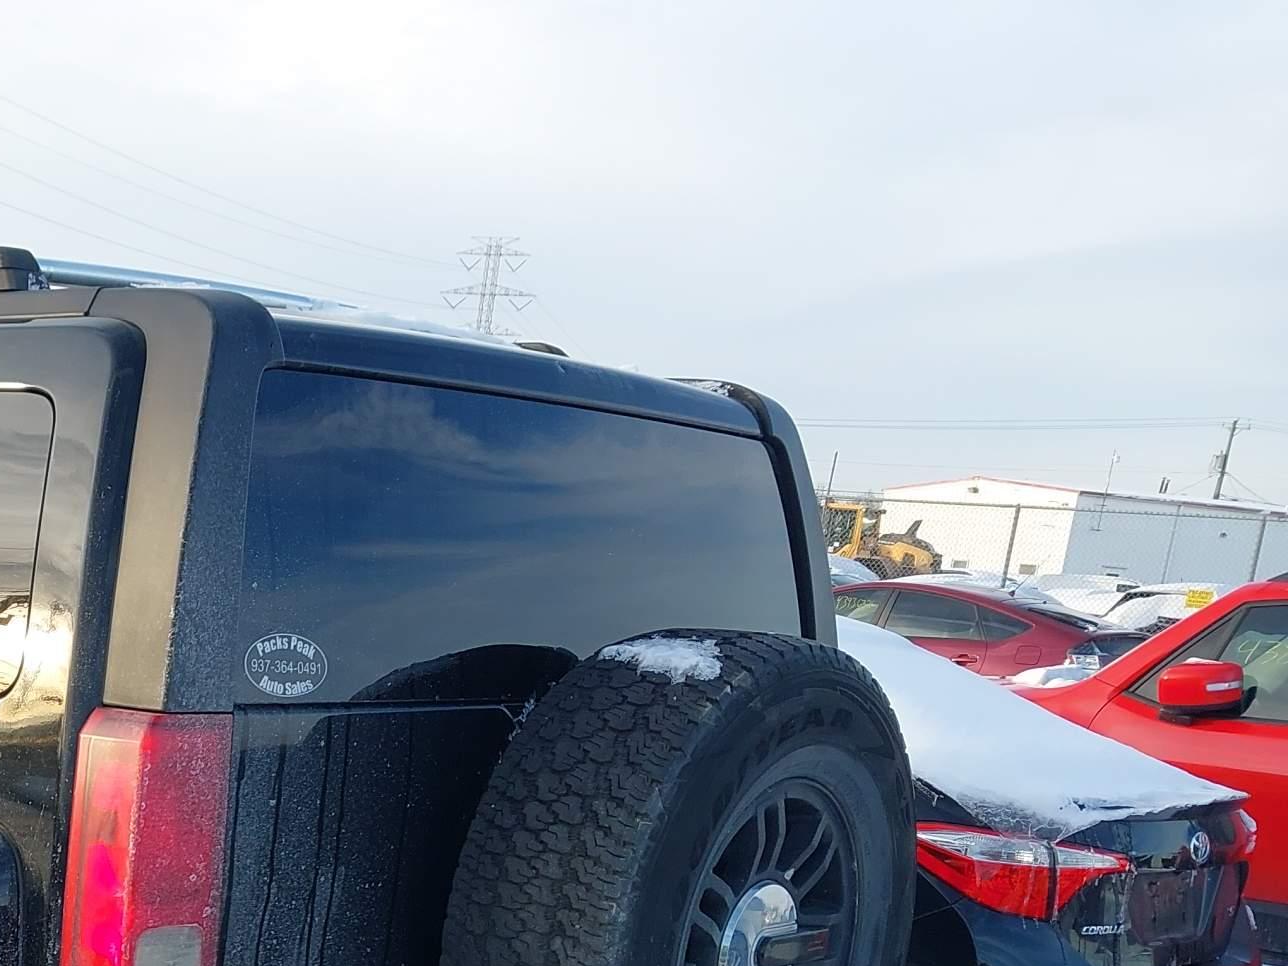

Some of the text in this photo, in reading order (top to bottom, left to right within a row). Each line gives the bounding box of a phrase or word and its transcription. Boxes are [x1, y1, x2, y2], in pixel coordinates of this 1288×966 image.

[256, 635, 316, 660] Packs Peak
[251, 658, 321, 675] 937-364-0491
[259, 675, 314, 695] Auto Sales
[1081, 924, 1125, 936] COROLLA
